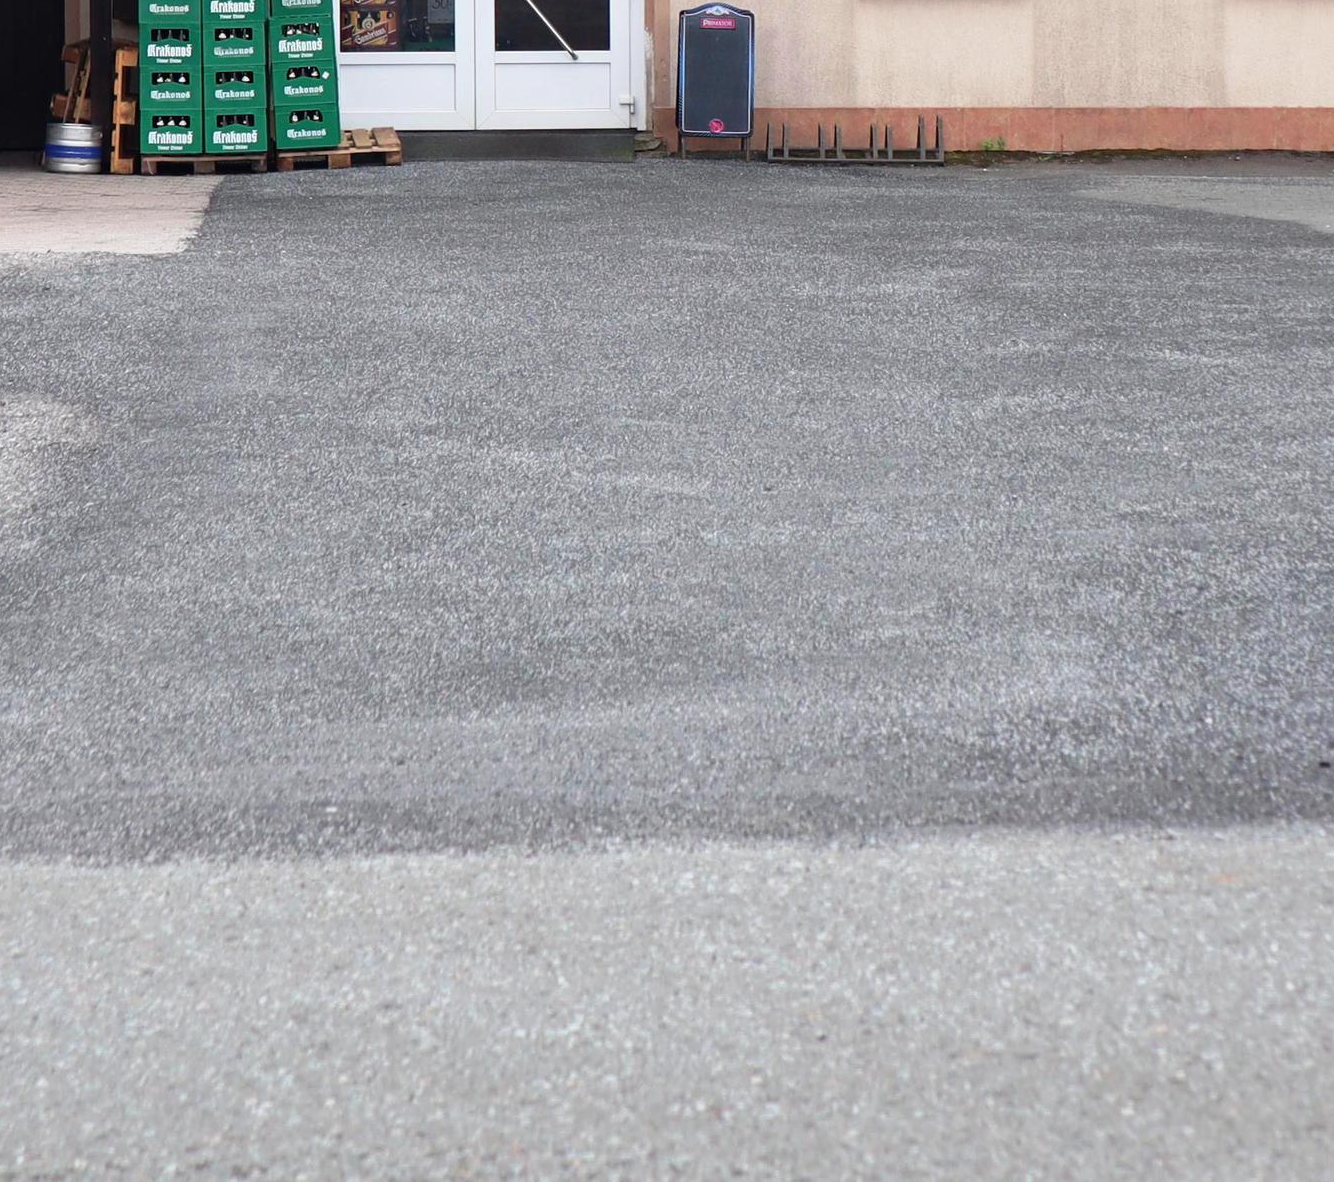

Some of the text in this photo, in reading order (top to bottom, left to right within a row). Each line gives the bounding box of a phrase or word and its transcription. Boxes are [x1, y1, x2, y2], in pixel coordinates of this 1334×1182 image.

[210, 0, 256, 13] Krakonoš
[147, 44, 193, 57] Krakonoš
[279, 38, 323, 53] Krakonoš
[148, 131, 193, 144] Krakonoš
[213, 130, 258, 144] Krakonoš
